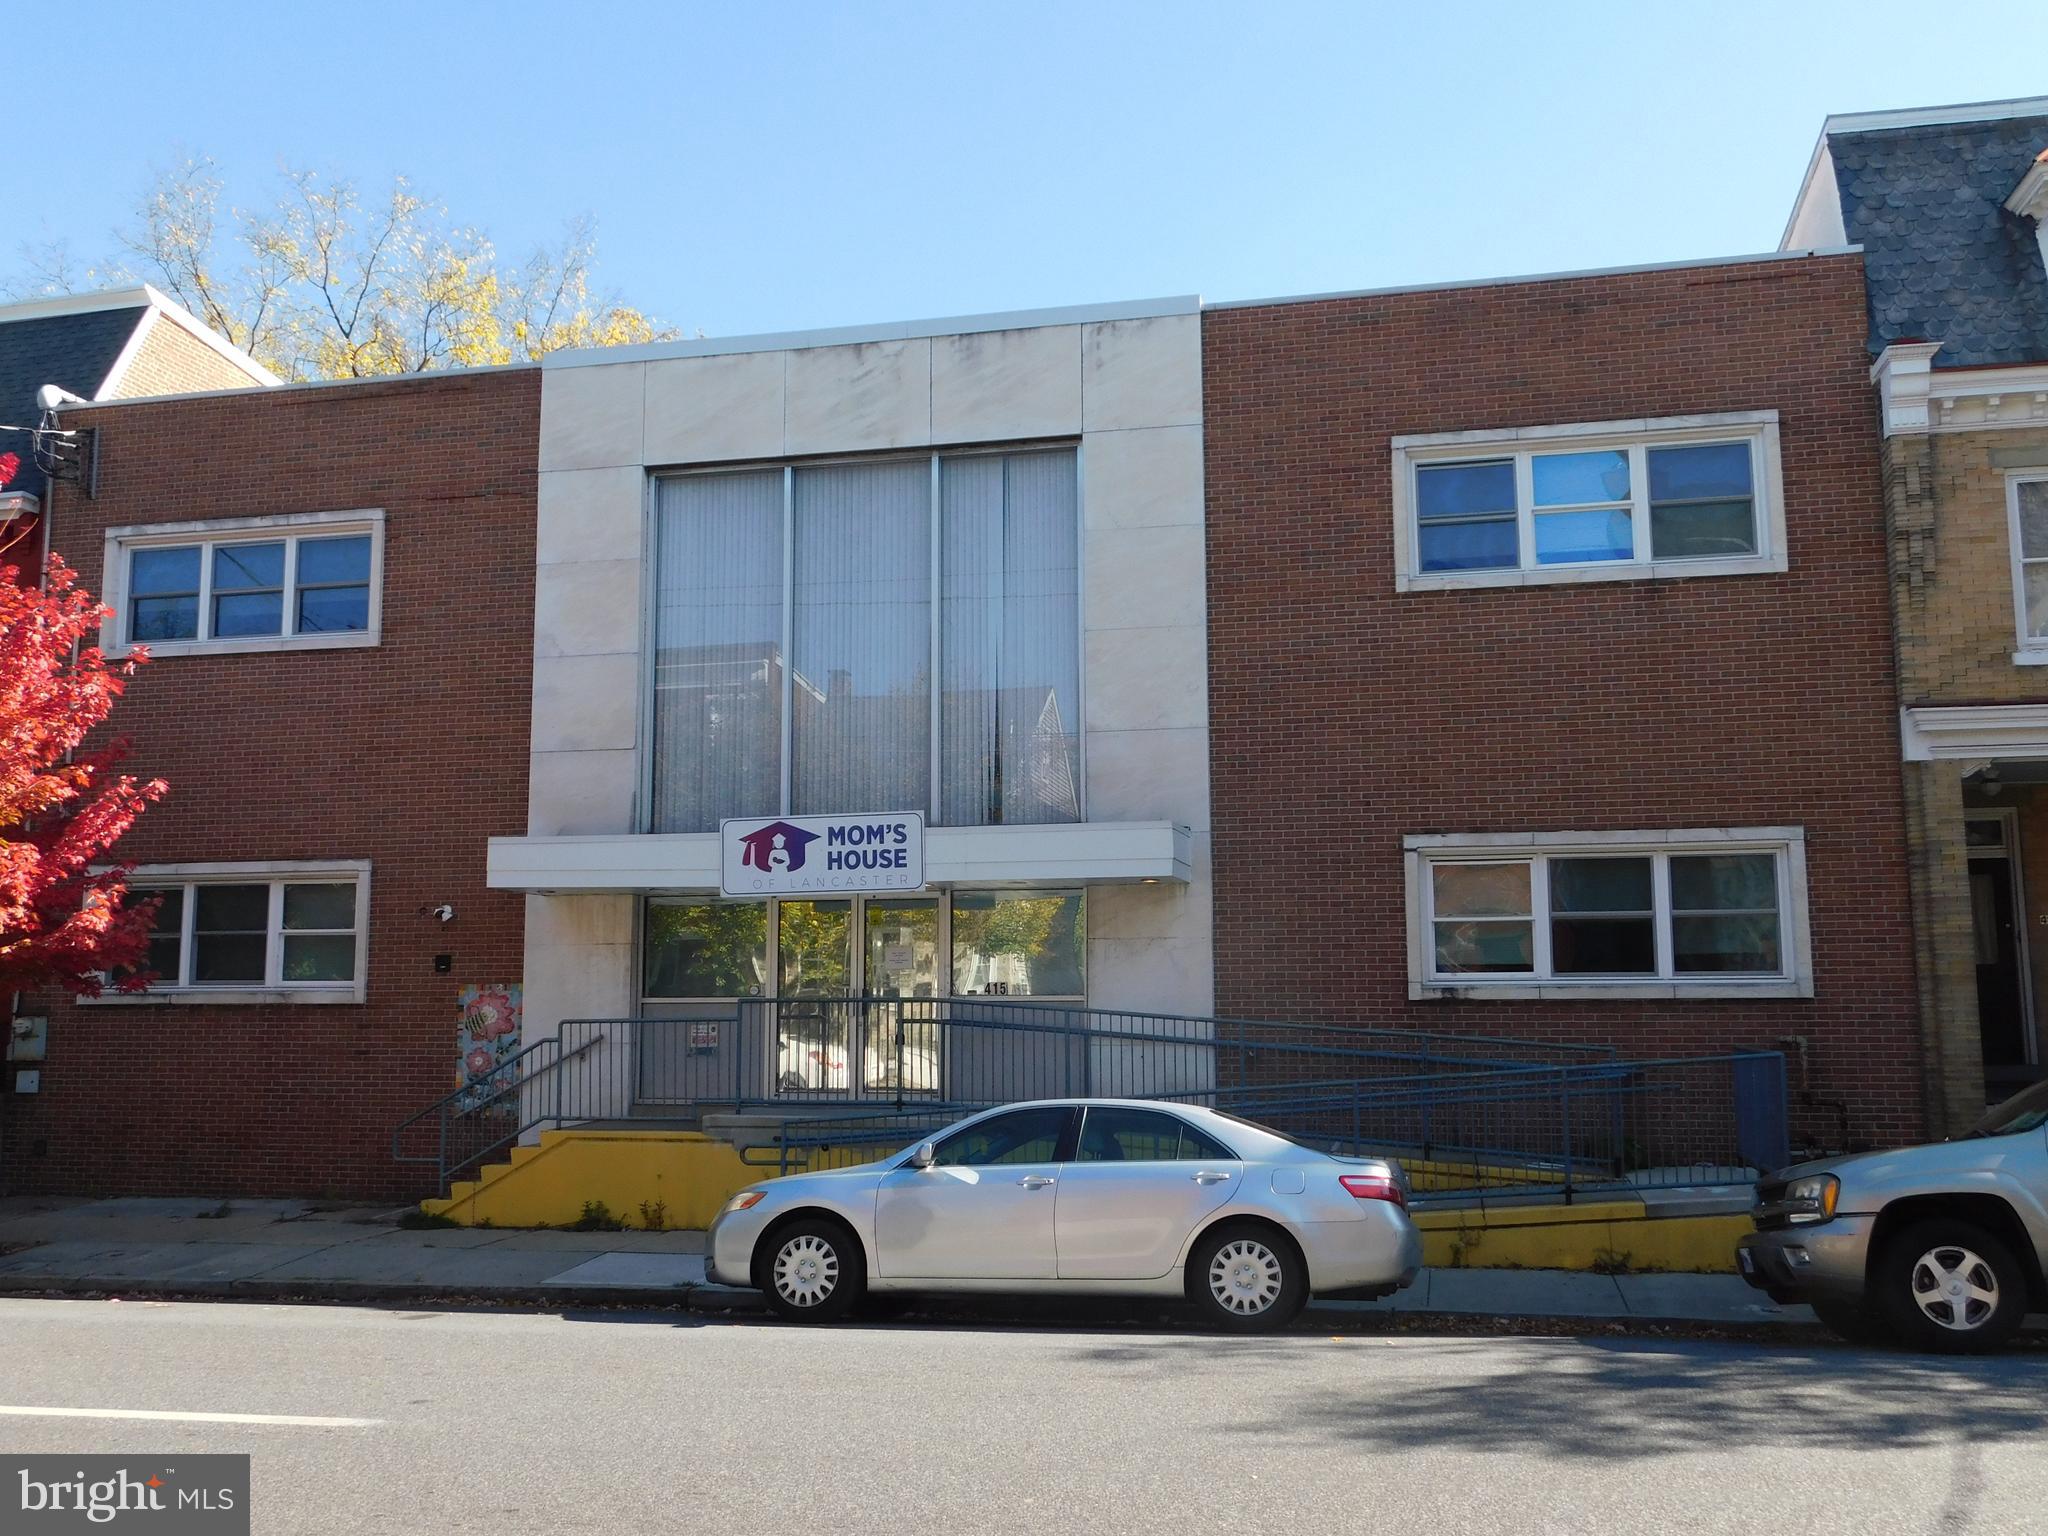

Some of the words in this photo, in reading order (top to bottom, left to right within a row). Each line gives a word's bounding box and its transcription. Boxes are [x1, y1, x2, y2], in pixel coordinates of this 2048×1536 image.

[827, 823, 907, 846] MOM'S
[827, 849, 908, 871] HOUSE
[752, 878, 775, 889] OF
[790, 875, 908, 889] LANCASTER
[984, 982, 1006, 995] 415
